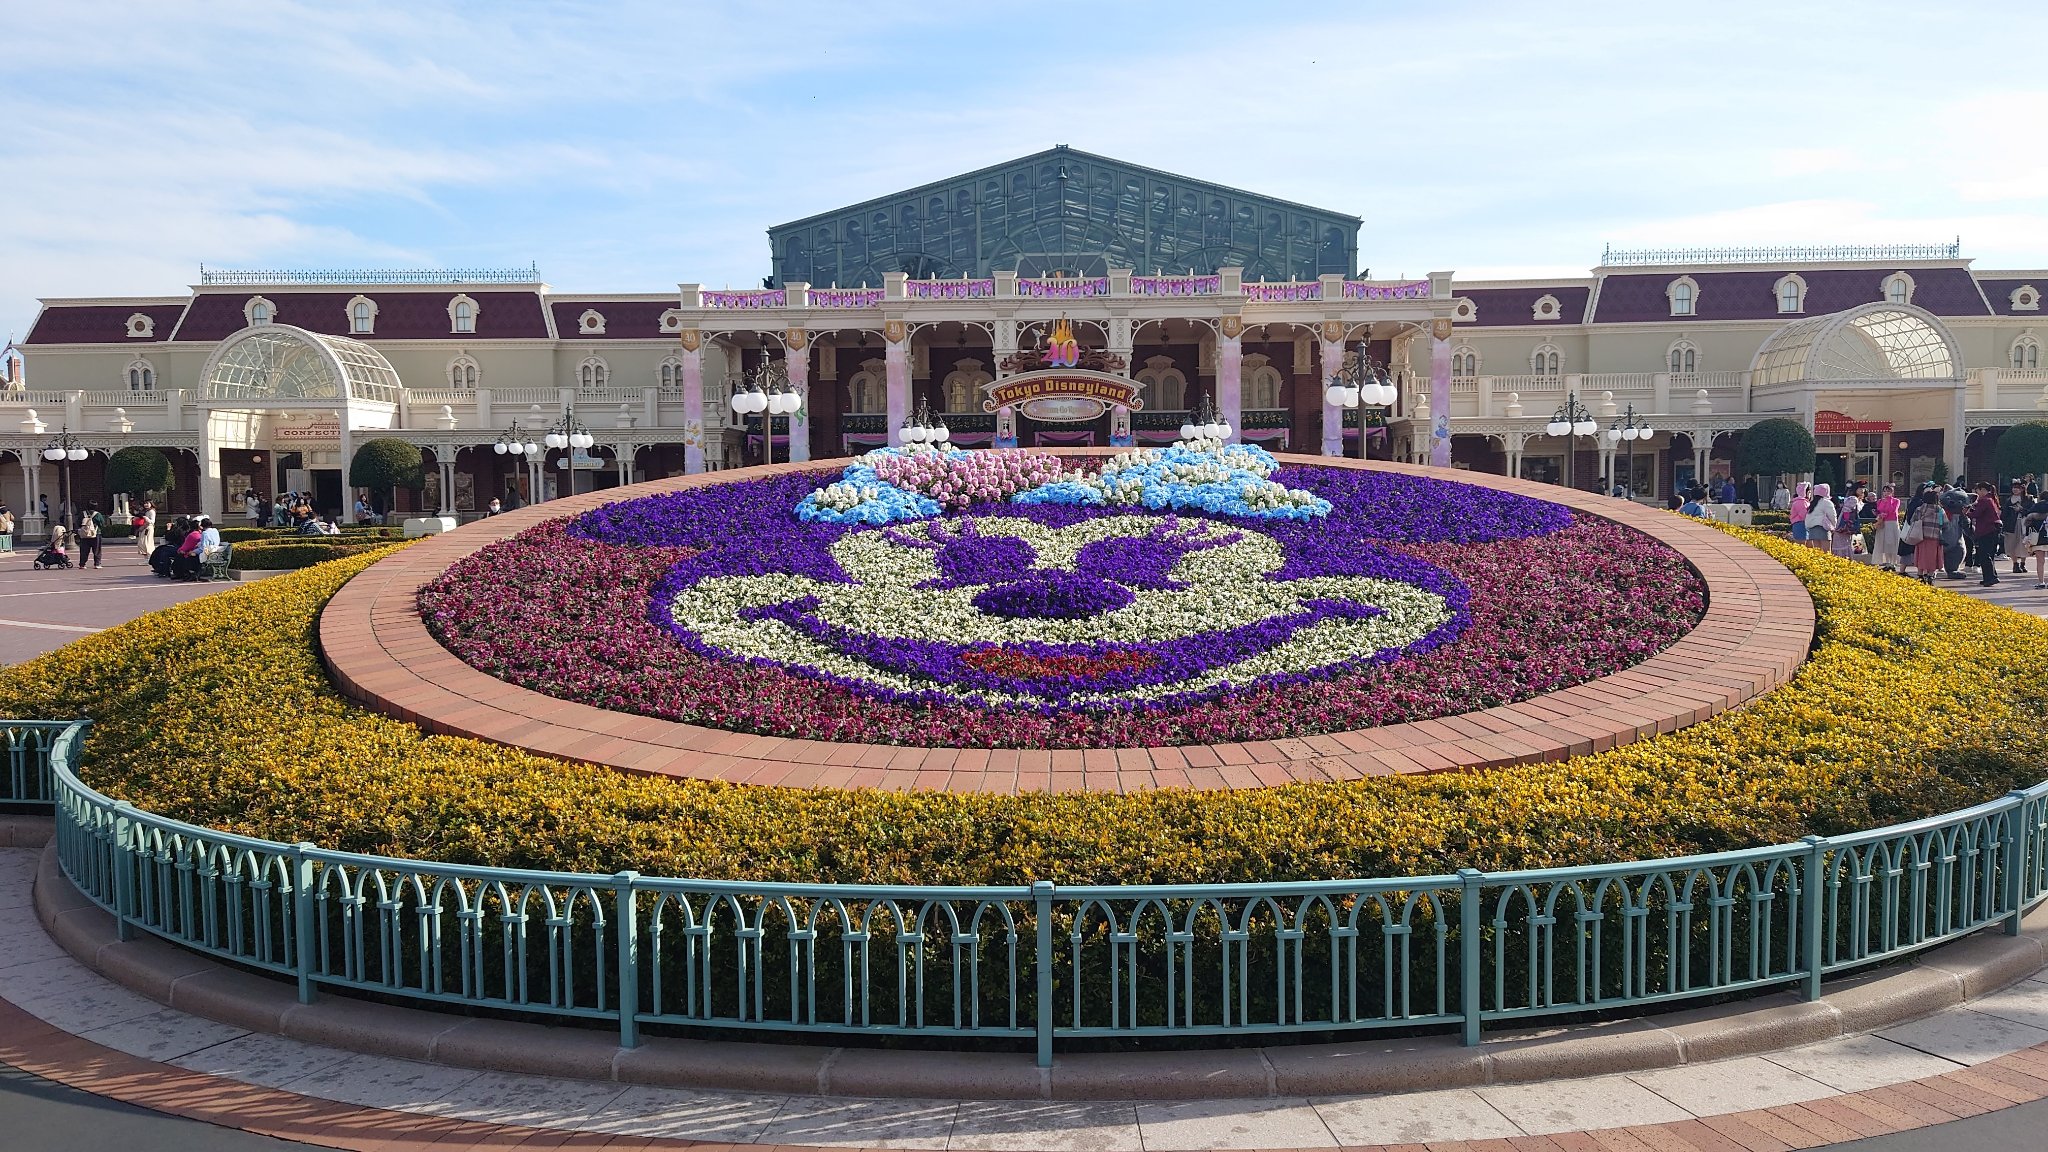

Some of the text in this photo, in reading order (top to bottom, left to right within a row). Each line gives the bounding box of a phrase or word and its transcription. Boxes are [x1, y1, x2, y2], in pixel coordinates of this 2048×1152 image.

[889, 323, 900, 334] 40
[1226, 319, 1237, 329] 40
[1327, 323, 1339, 335] 40
[1437, 320, 1448, 331] 40
[685, 332, 696, 342] 40
[791, 331, 802, 342] 40
[1041, 337, 1080, 367] 40
[998, 380, 1127, 400] Tokyo Disneyland
